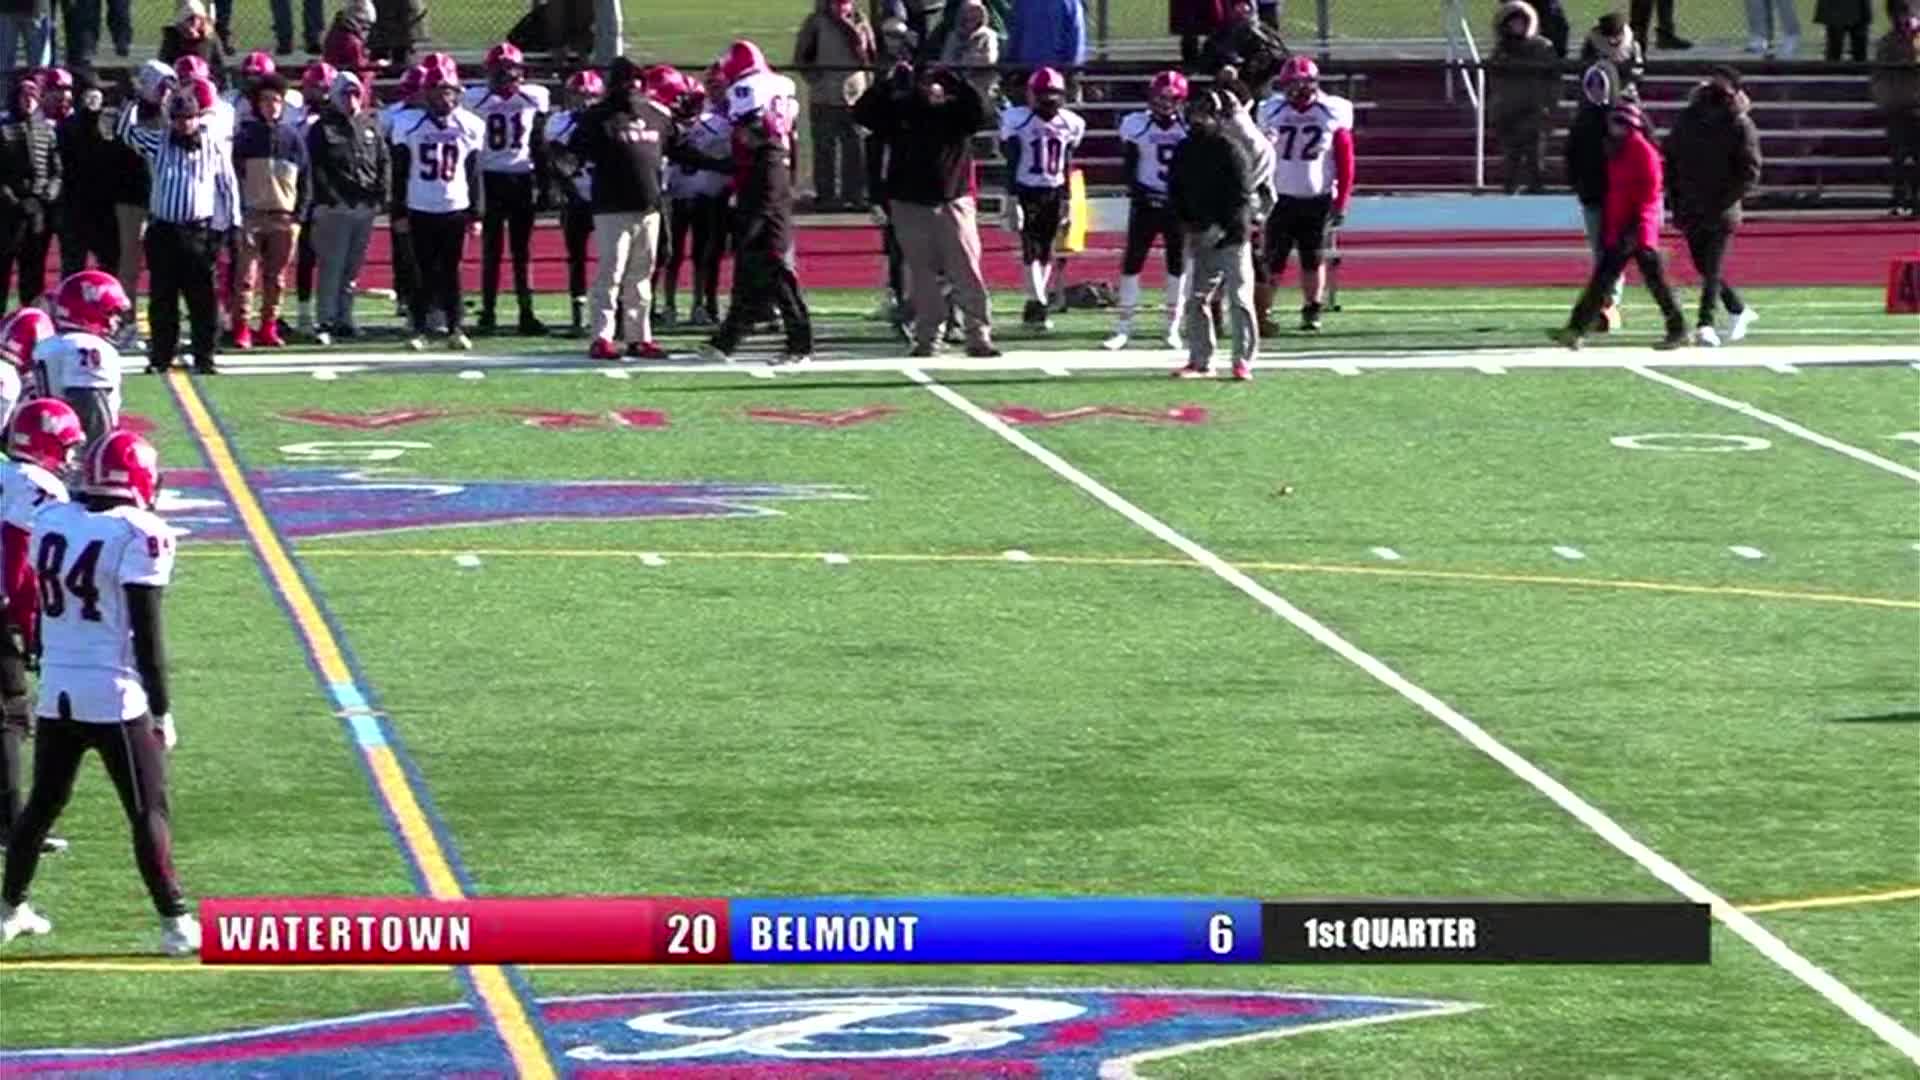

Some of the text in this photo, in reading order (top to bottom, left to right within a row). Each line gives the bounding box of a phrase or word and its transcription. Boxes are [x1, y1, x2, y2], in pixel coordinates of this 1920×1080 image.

[488, 113, 525, 150] 81
[1279, 125, 1323, 161] 72
[419, 143, 458, 182] 50
[1028, 137, 1062, 176] 10
[37, 532, 105, 622] 84
